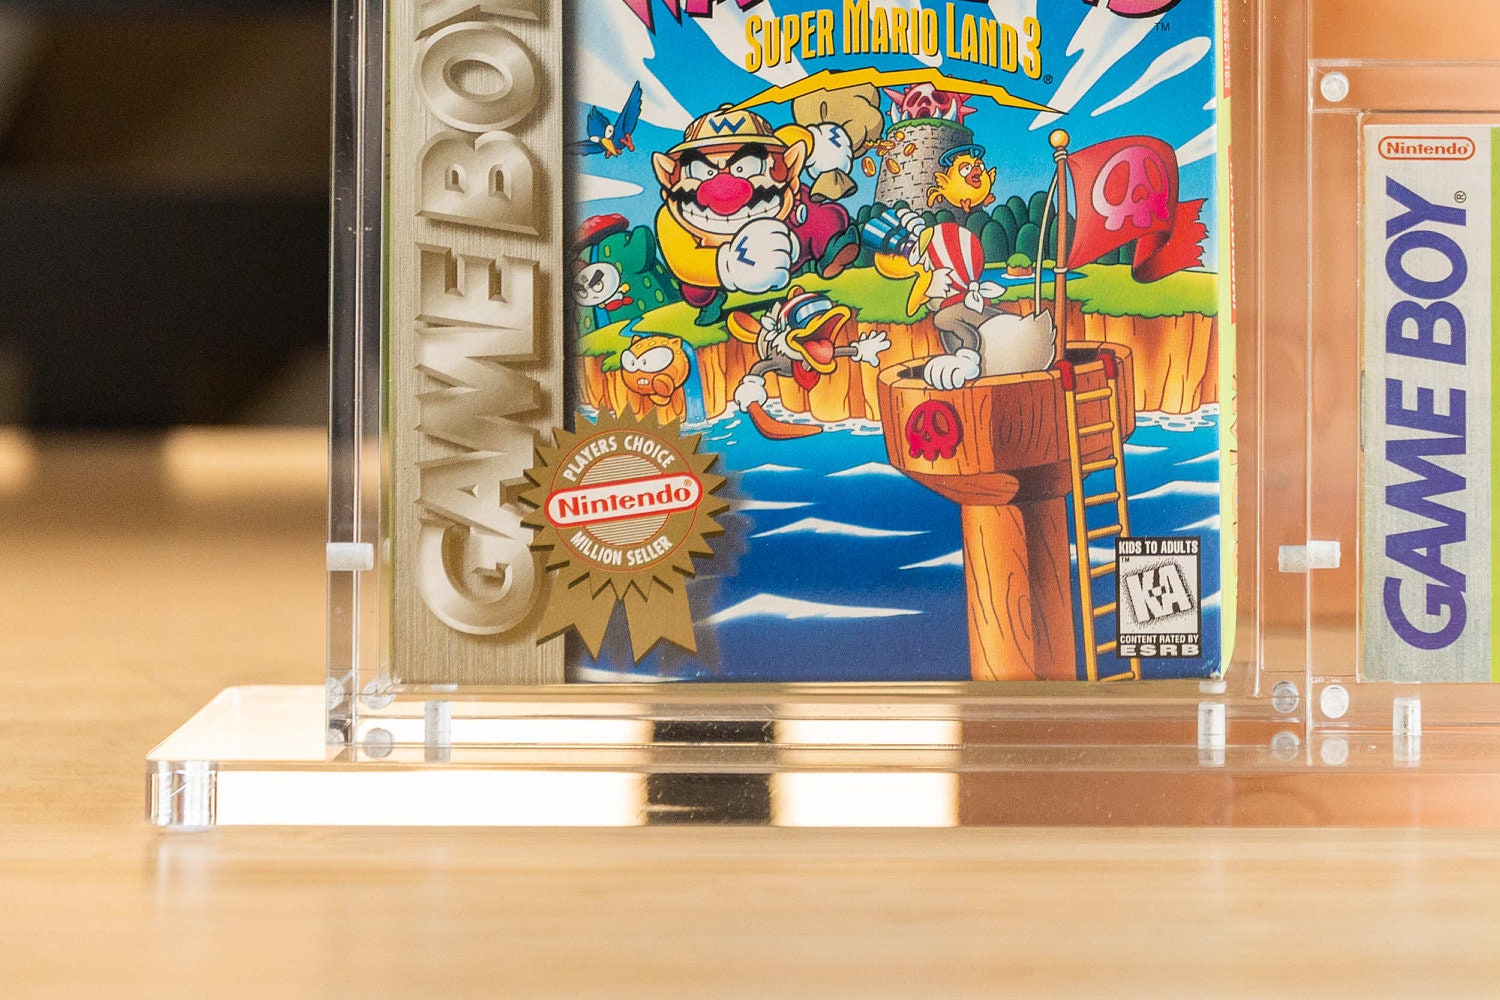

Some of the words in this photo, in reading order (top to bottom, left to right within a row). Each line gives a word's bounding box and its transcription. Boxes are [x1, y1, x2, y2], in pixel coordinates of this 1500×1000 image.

[745, 13, 835, 74] SUPER
[946, 1, 1019, 73] LAND
[1022, 16, 1042, 80] 3
[1386, 141, 1470, 156] Nintendo
[1385, 175, 1468, 367] BOY
[562, 435, 618, 482] PLAYERS
[624, 434, 676, 469] CHOICE
[558, 484, 692, 519] Nintendo
[1383, 377, 1468, 650] GAME
[570, 530, 622, 566] MILLION
[626, 535, 674, 567] SELLER
[1118, 540, 1142, 555] KIDS
[1145, 540, 1158, 555] TO
[1160, 540, 1199, 554] ADULTS
[1120, 634, 1157, 644] CONTENT
[1159, 634, 1186, 644] RATED
[1187, 634, 1199, 644] BY
